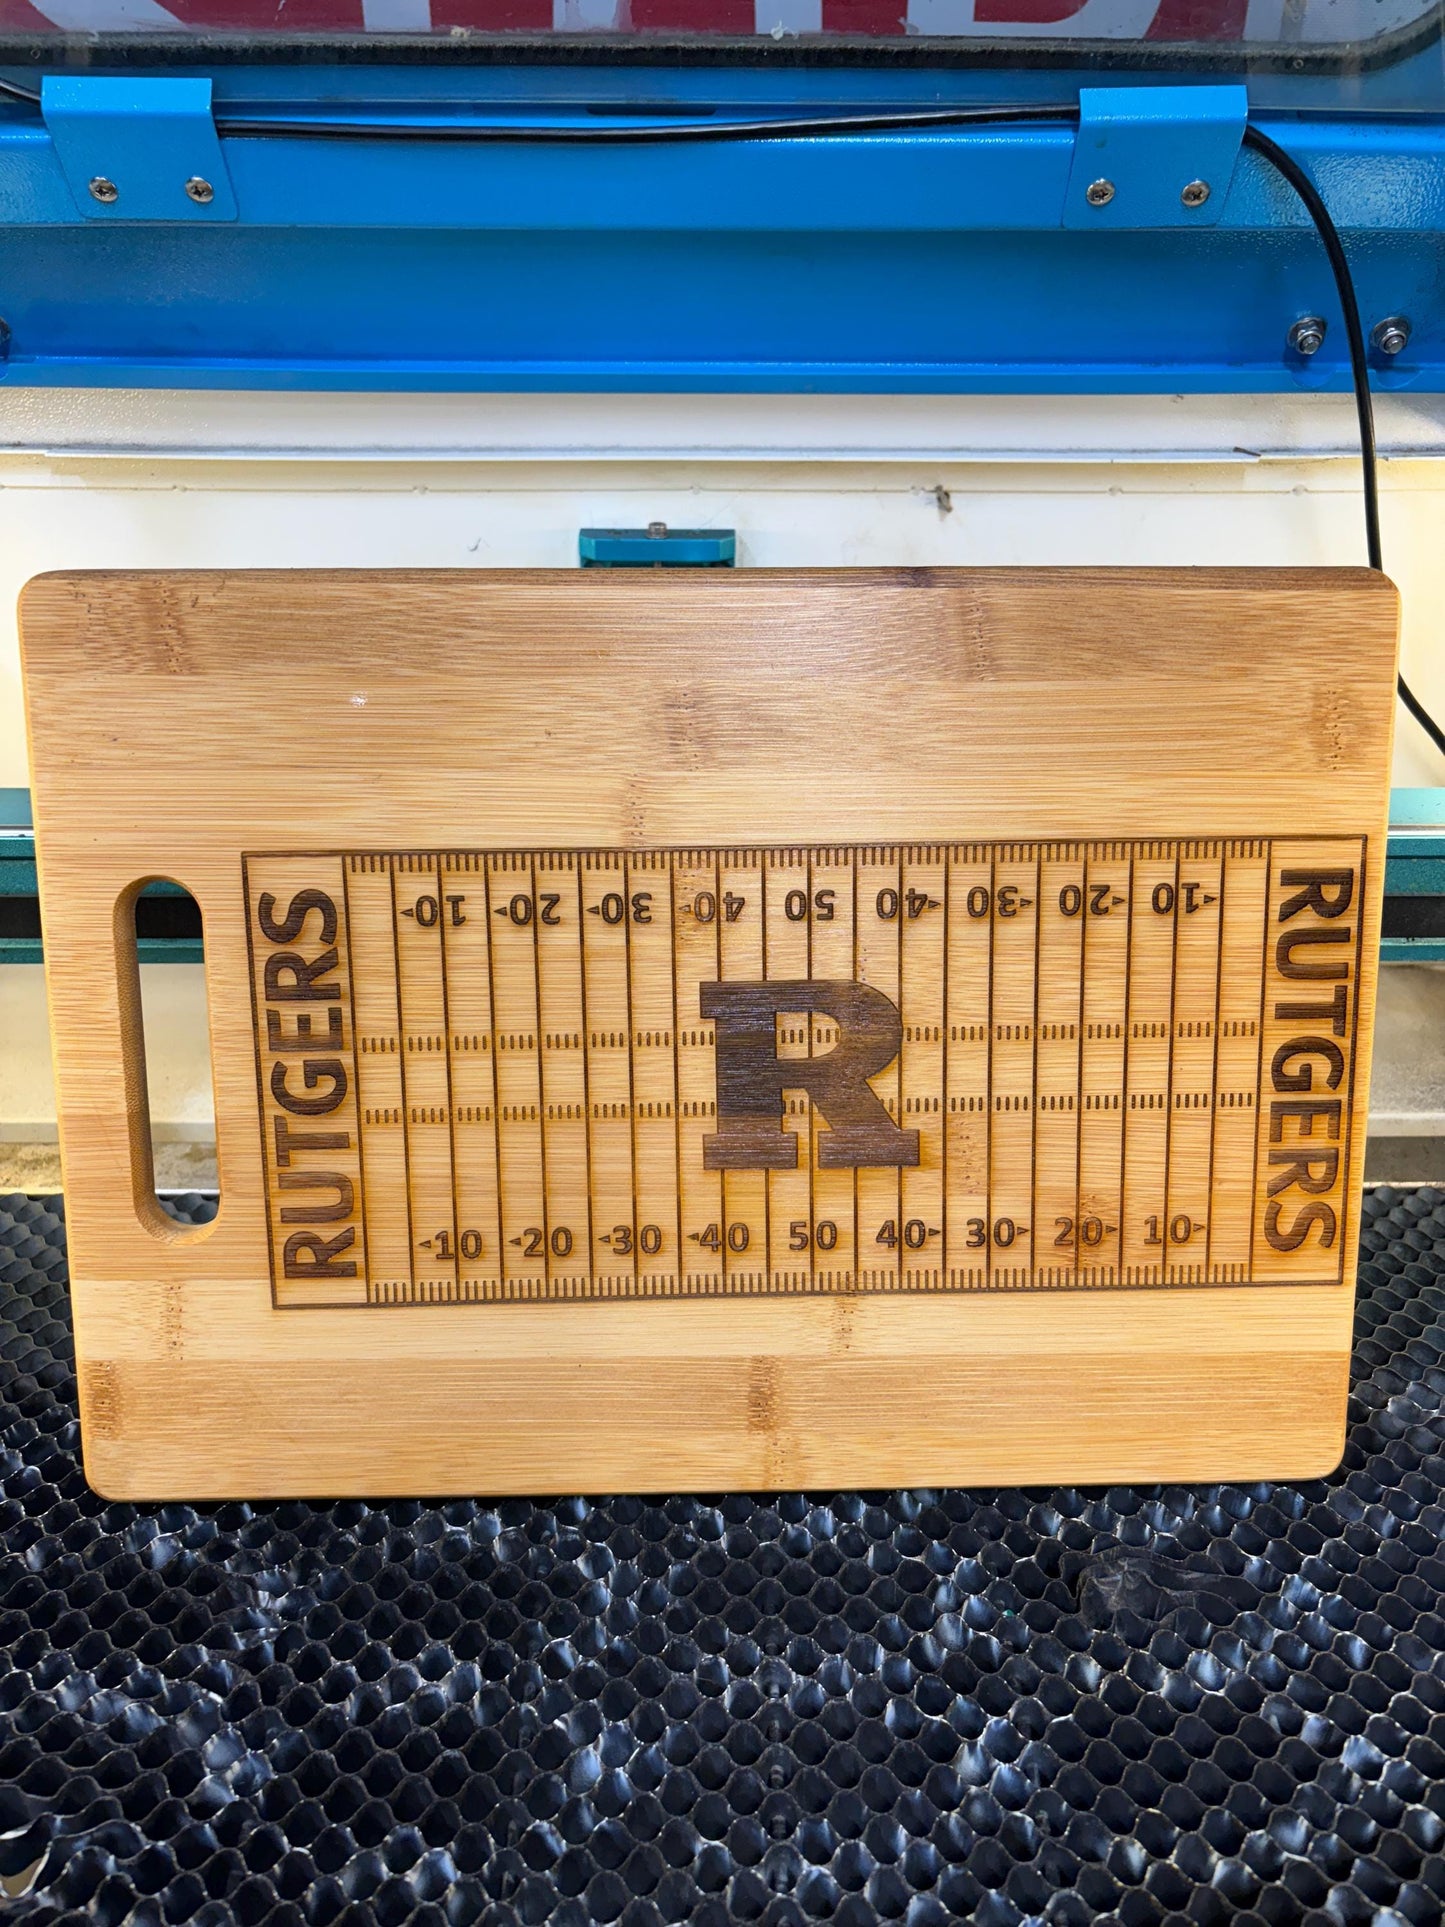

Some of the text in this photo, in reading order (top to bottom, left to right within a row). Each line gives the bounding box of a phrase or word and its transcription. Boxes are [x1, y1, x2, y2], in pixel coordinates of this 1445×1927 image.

[415, 883, 1200, 926] 10 20 30 40 50 40 30 20 10
[257, 888, 359, 1280] RUTGERS
[699, 978, 921, 1171] R
[1263, 867, 1355, 1253] RUTGERS
[435, 1214, 1191, 1260] 10 20 30 40 50 40 30 20 10
